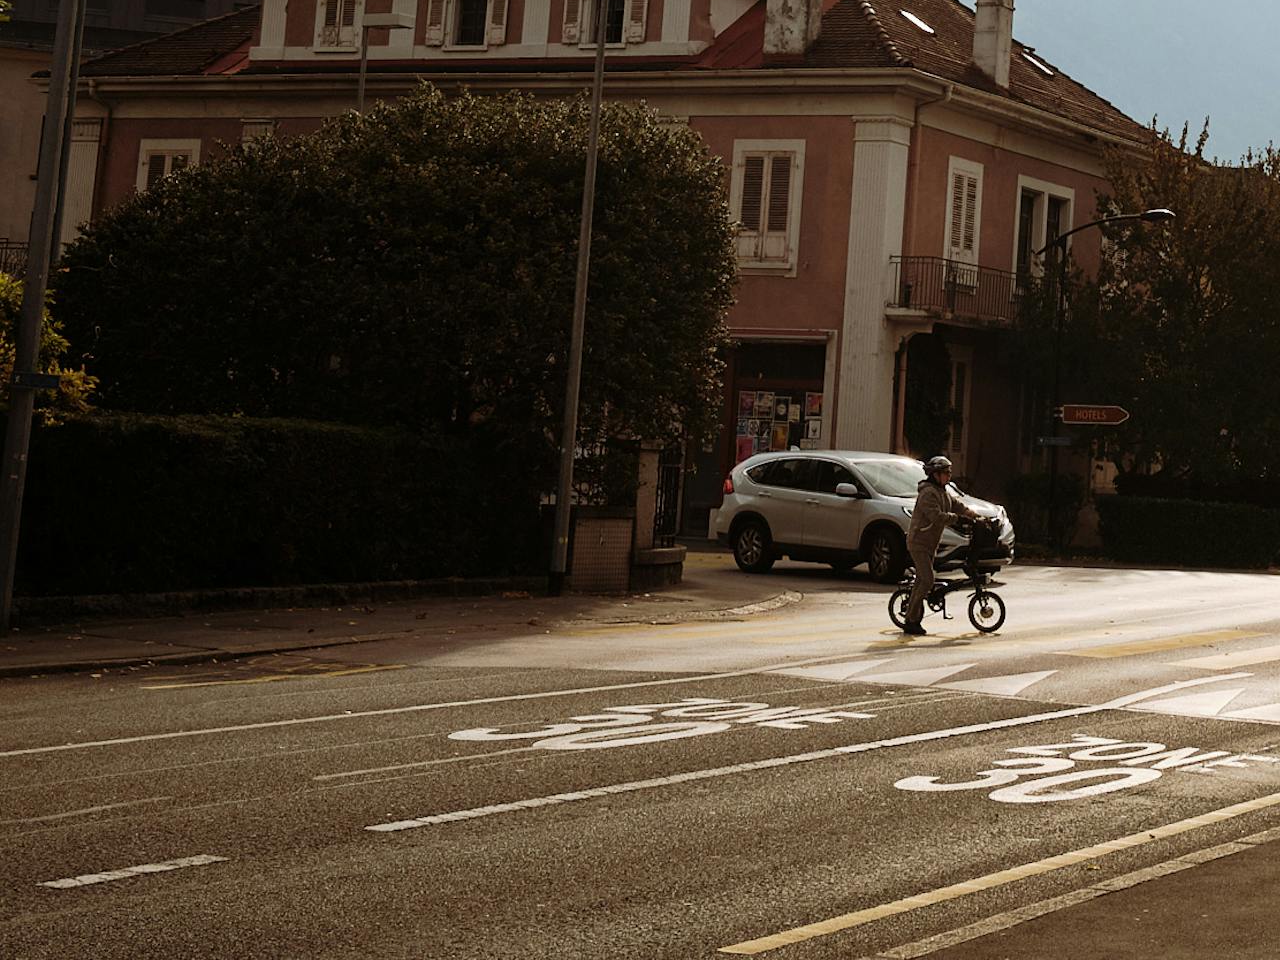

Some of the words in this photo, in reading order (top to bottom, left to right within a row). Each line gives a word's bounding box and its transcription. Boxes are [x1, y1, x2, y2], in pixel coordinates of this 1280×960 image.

[1075, 408, 1107, 420] HOTELS
[447, 713, 731, 751] 30
[602, 697, 878, 730] ZONE
[1005, 733, 1280, 772] ZONE
[893, 756, 1163, 803] 30
